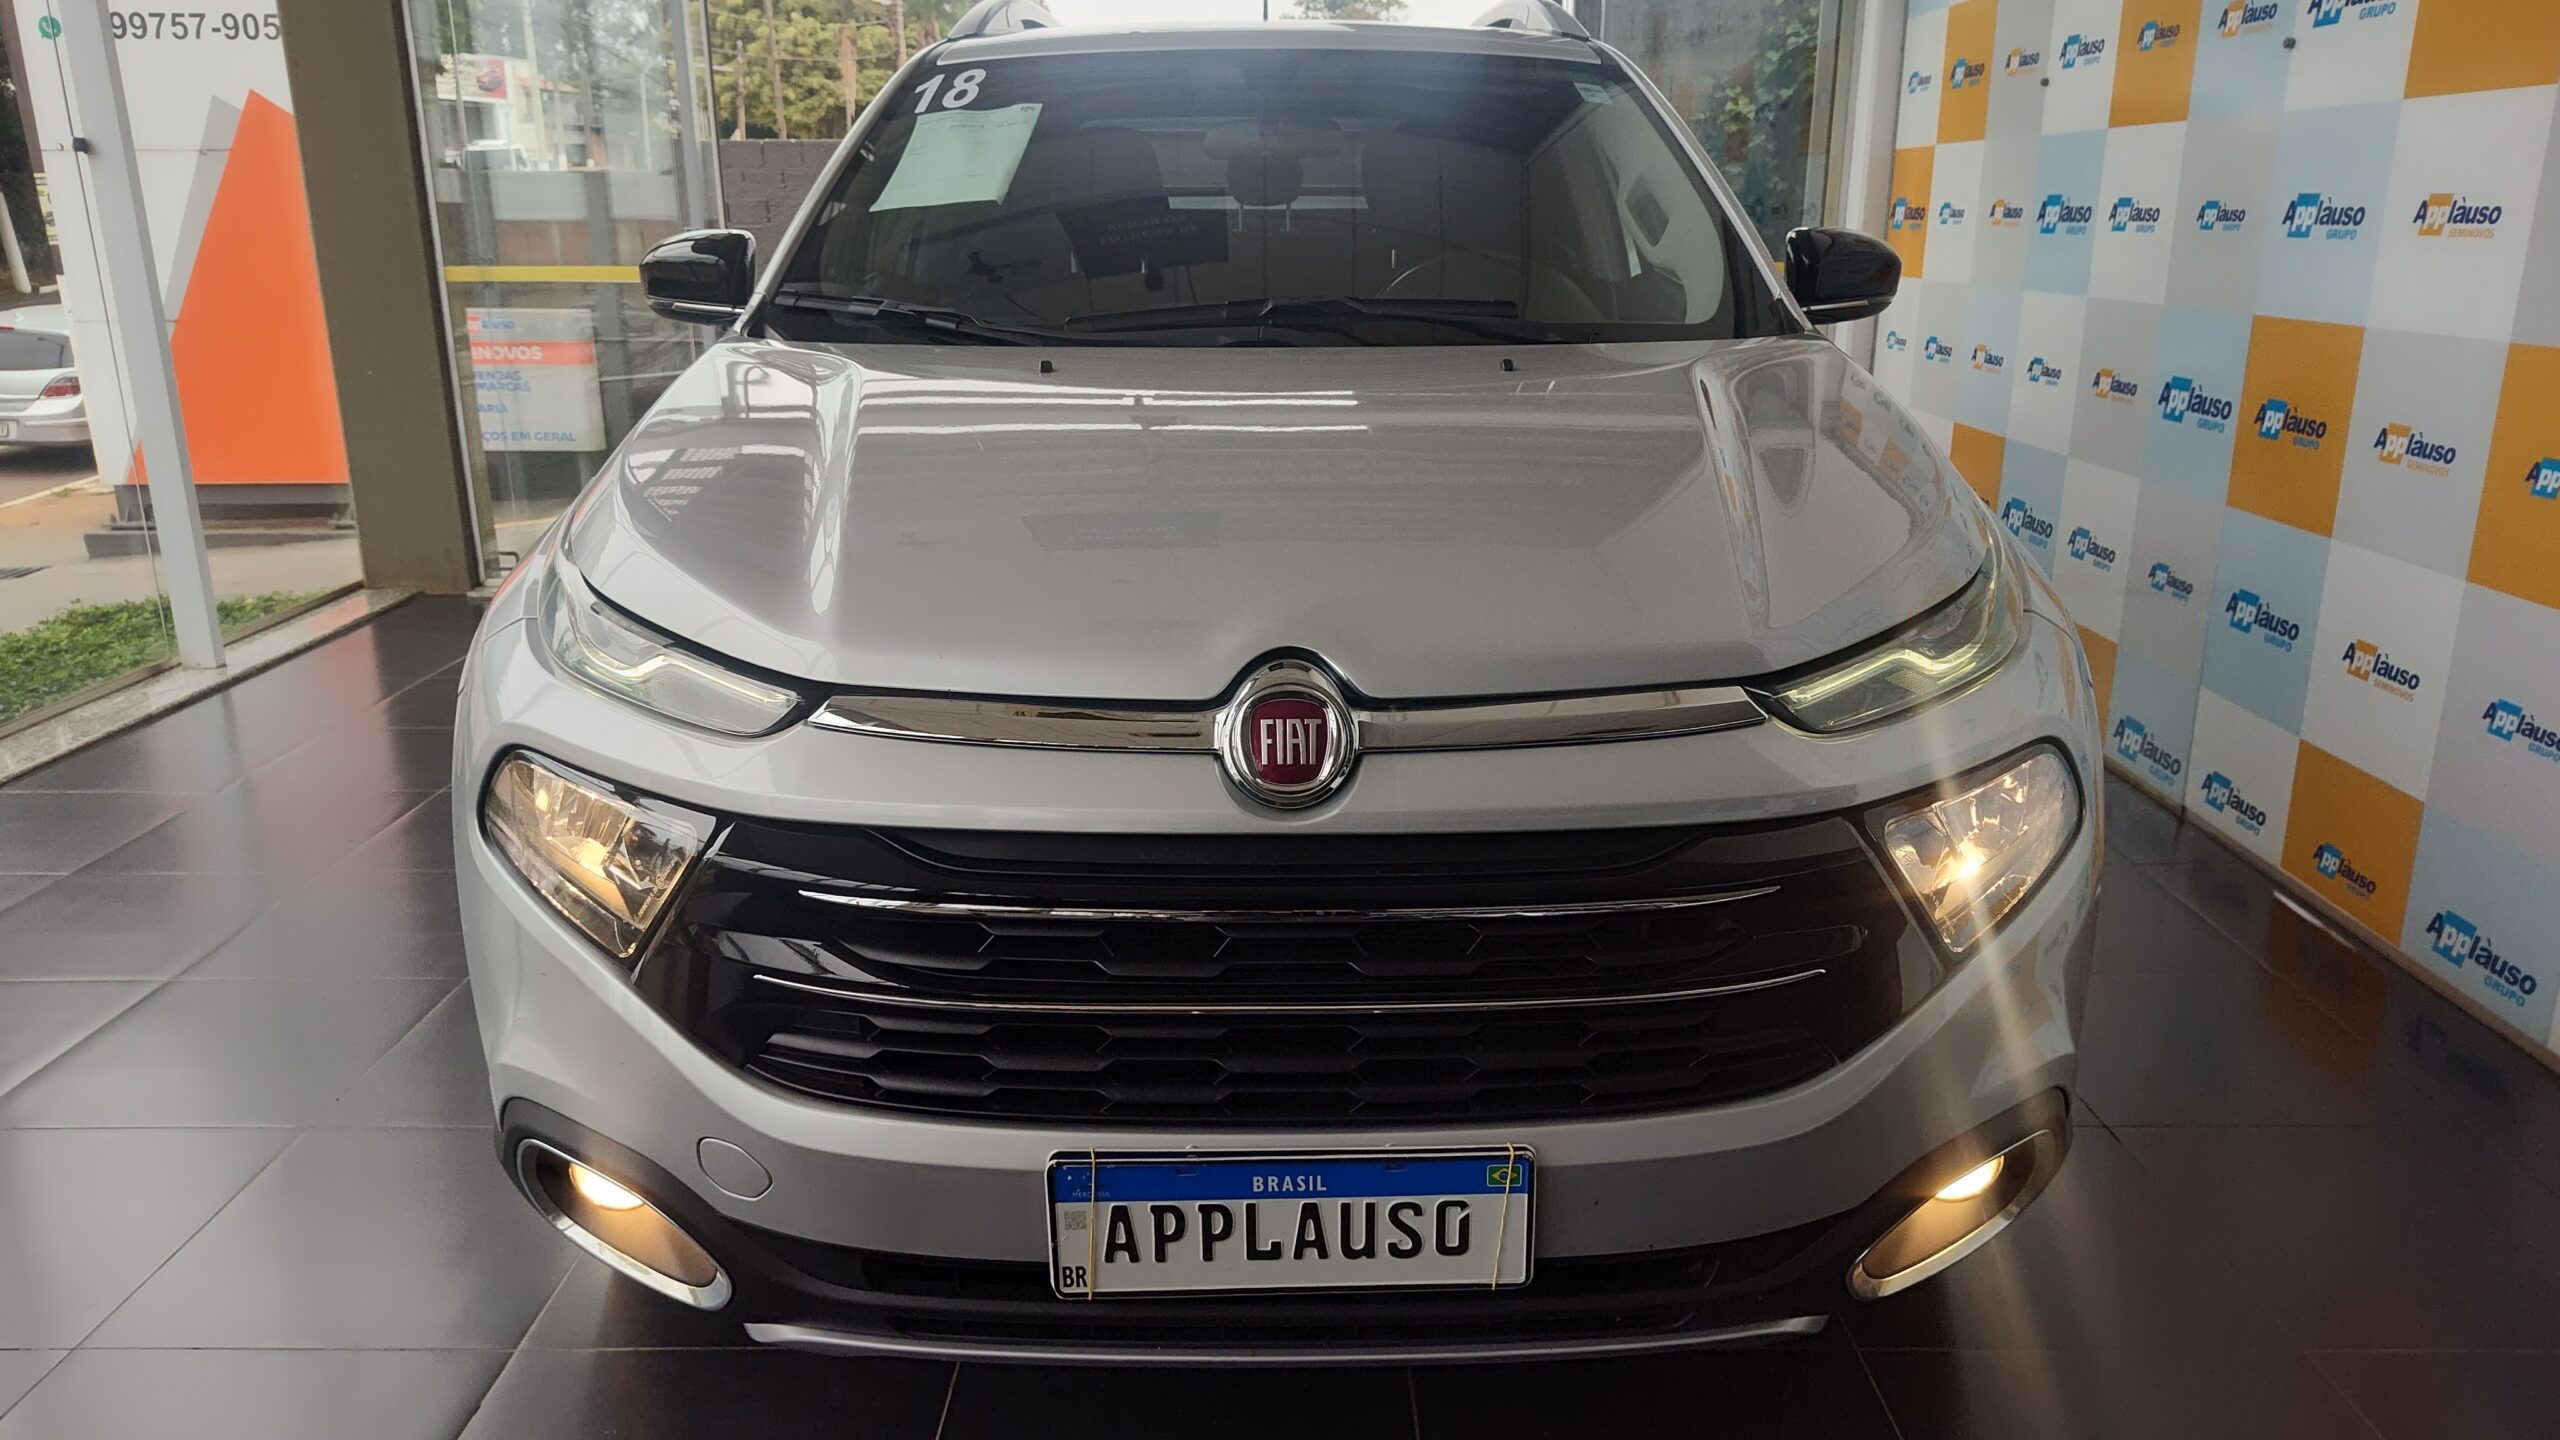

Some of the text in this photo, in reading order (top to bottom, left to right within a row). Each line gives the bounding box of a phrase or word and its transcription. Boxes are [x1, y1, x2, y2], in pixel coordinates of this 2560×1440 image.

[2359, 2, 2396, 20] GRUPO
[913, 68, 987, 114] 18
[2326, 228, 2357, 240] GRUPO
[2447, 227, 2496, 239] SEMINOVOS
[2196, 417, 2226, 434] GRUPO
[2263, 633, 2294, 653] GRUPO
[1260, 718, 1322, 766] FIAT
[2483, 974, 2526, 1008] GRUPO
[1252, 1175, 1328, 1193] BRASIL
[1062, 1265, 1088, 1288] BR
